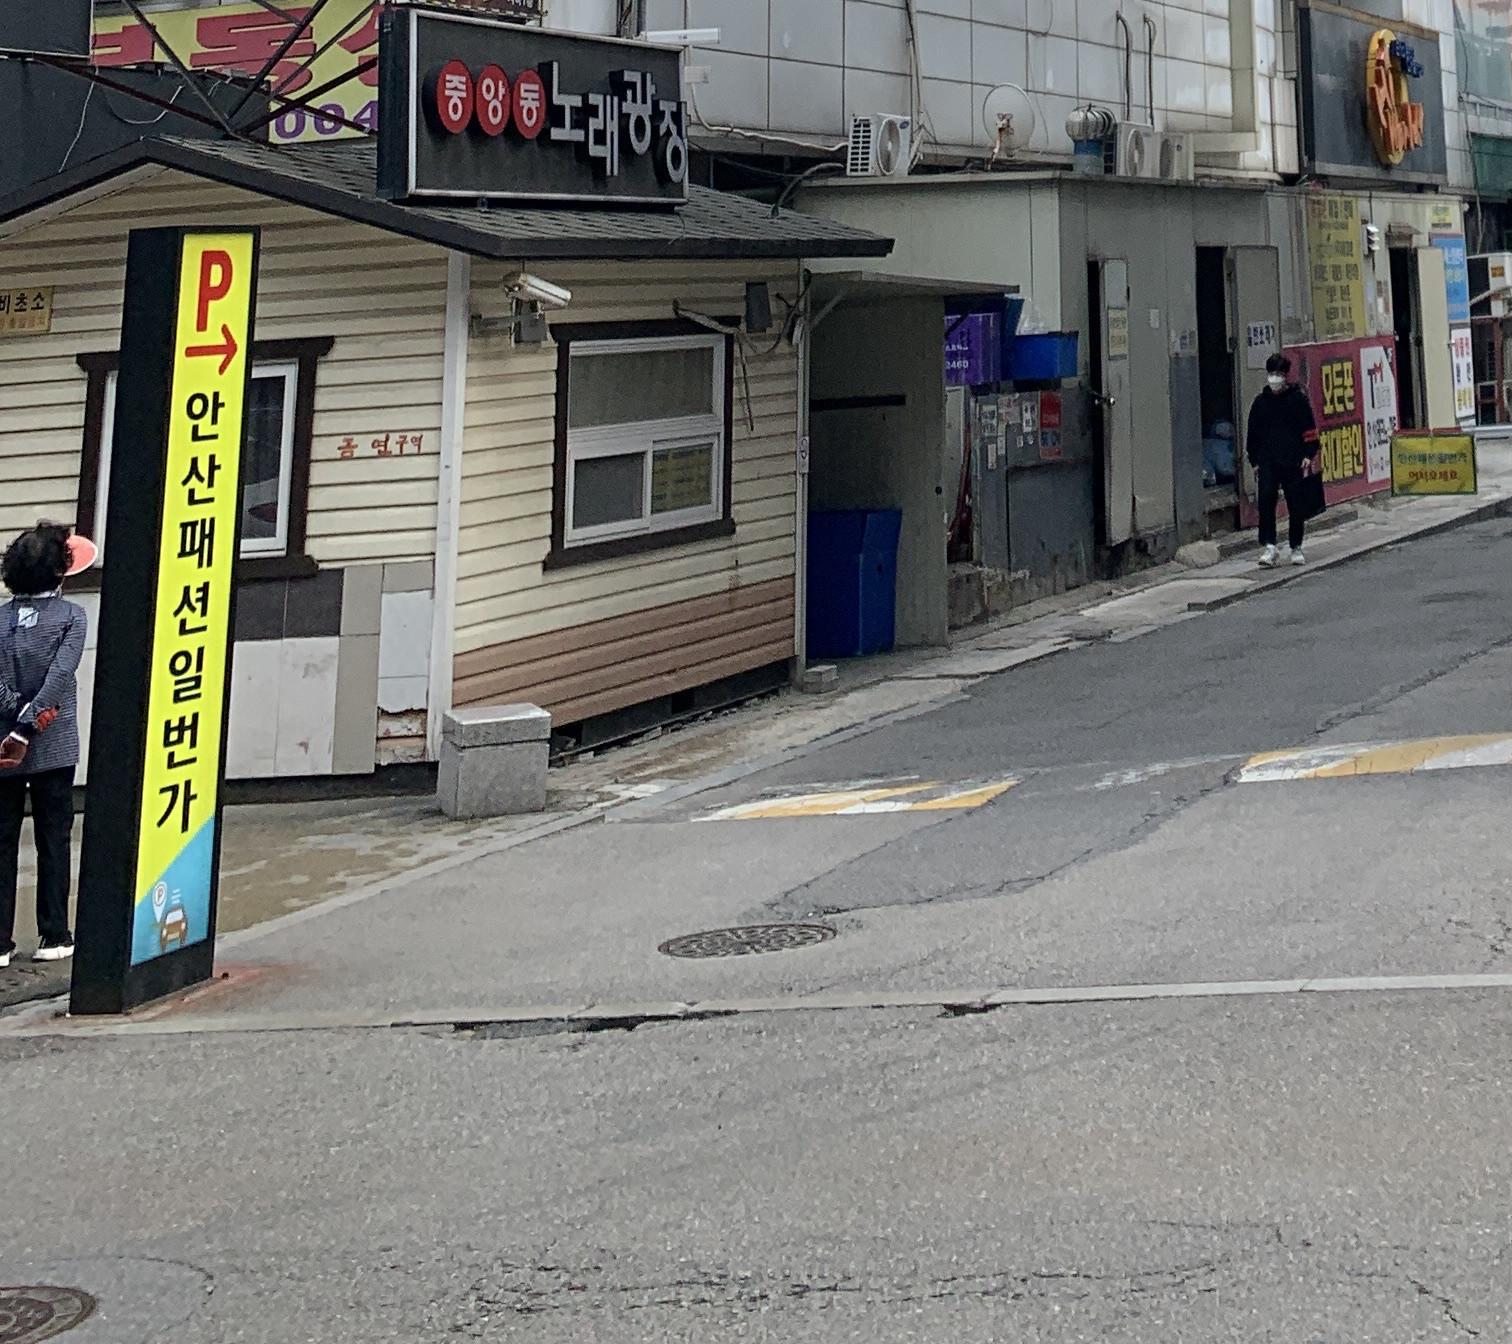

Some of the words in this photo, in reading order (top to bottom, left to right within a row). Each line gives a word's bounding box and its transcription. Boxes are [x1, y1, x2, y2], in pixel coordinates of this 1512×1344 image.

[434, 58, 547, 139] 중앙동
[549, 59, 688, 184] 노래광장
[195, 248, 235, 333] P
[156, 389, 228, 836] 안산패션일번가
